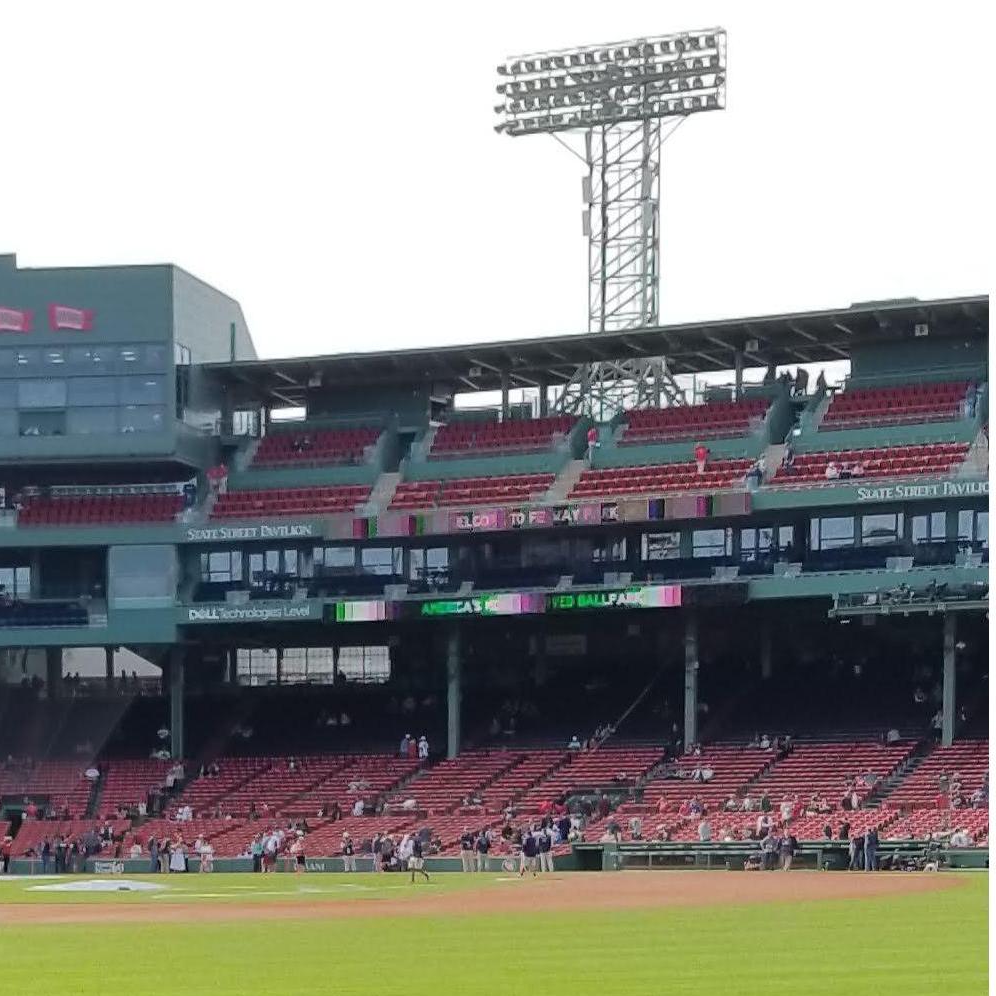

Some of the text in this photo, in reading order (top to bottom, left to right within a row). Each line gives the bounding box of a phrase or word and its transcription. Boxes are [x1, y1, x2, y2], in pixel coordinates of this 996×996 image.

[857, 487, 894, 500] STATE
[895, 484, 938, 497] STREET
[187, 525, 312, 541] STATE STREET PAVILION
[188, 604, 310, 620] DELL Technologies Level
